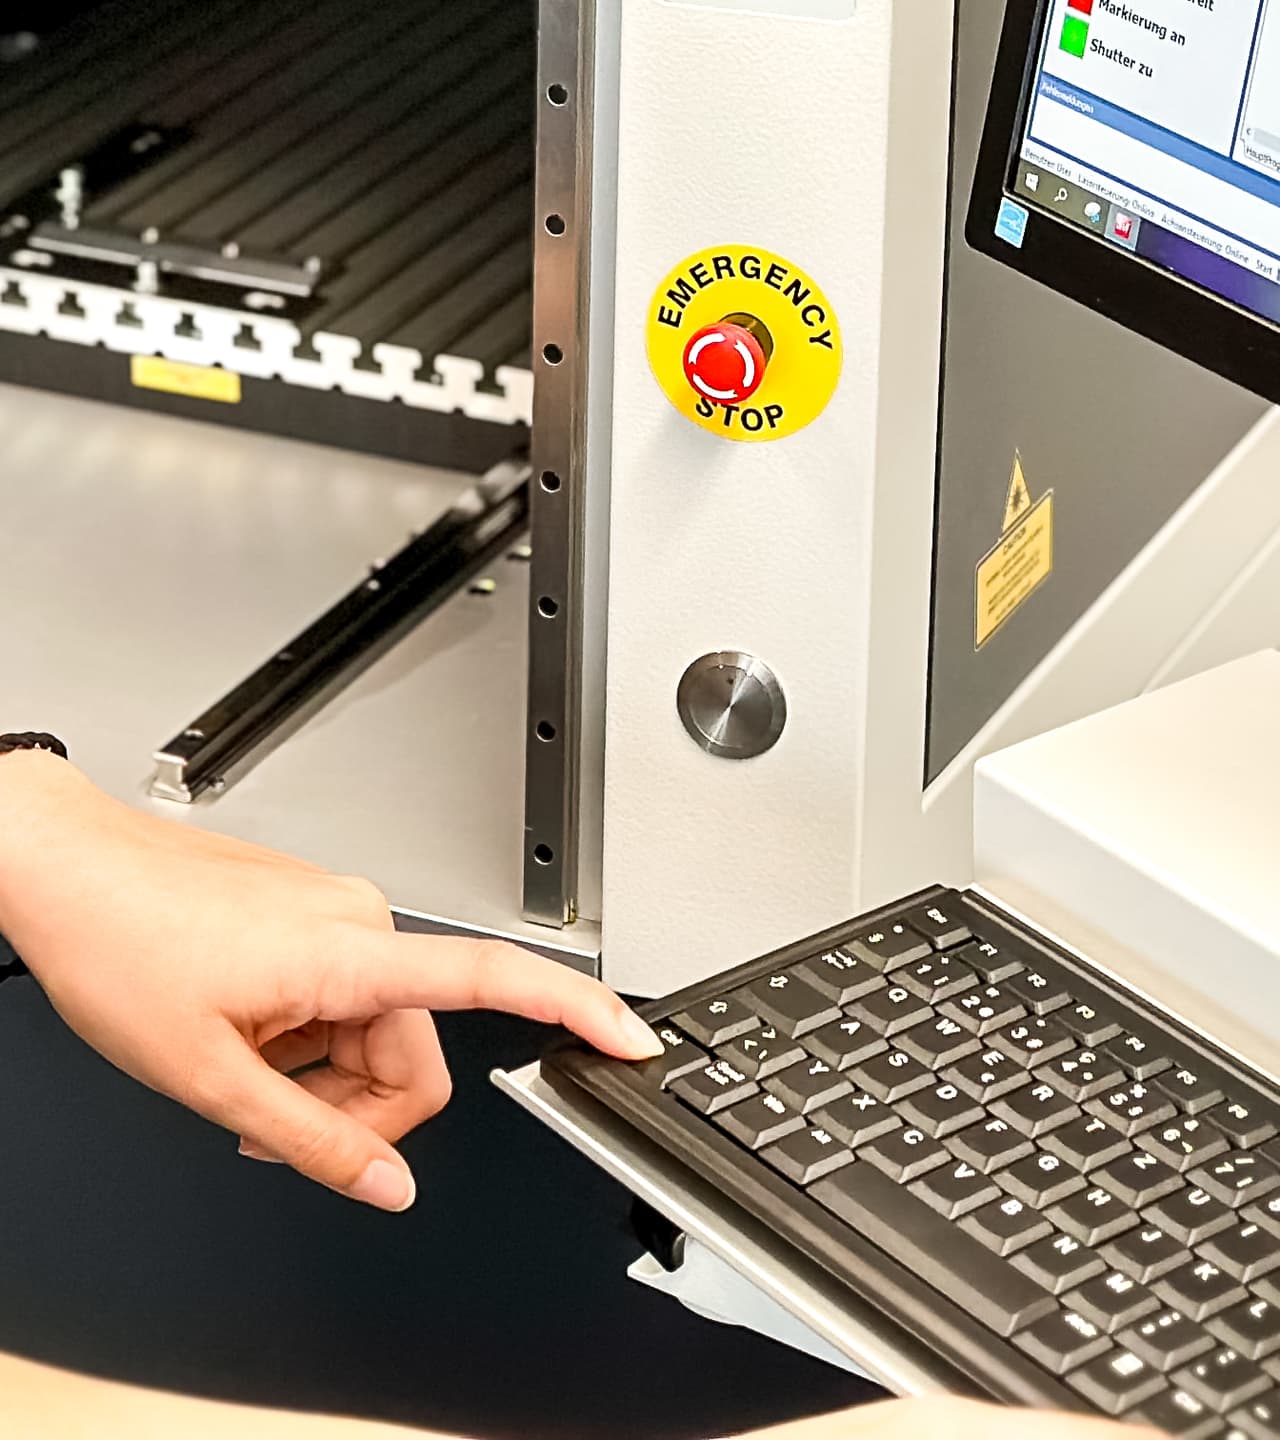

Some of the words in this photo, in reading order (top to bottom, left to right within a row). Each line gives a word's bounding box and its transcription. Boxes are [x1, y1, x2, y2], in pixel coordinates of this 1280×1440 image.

[1170, 31, 1185, 46] an
[1089, 38, 1136, 68] Shutter
[1138, 63, 1153, 77] zu
[658, 255, 833, 350] EMERGENCY
[695, 397, 783, 431] STOP
[935, 1018, 961, 1036] W
[808, 1061, 829, 1075] Y
[888, 1052, 909, 1067] S
[852, 1094, 877, 1111] X
[903, 1130, 924, 1144] C
[954, 1162, 975, 1179] V
[1087, 1189, 1111, 1206] H
[1188, 1189, 1211, 1206] U
[1053, 1236, 1079, 1255] N
[1193, 1263, 1219, 1281] K
